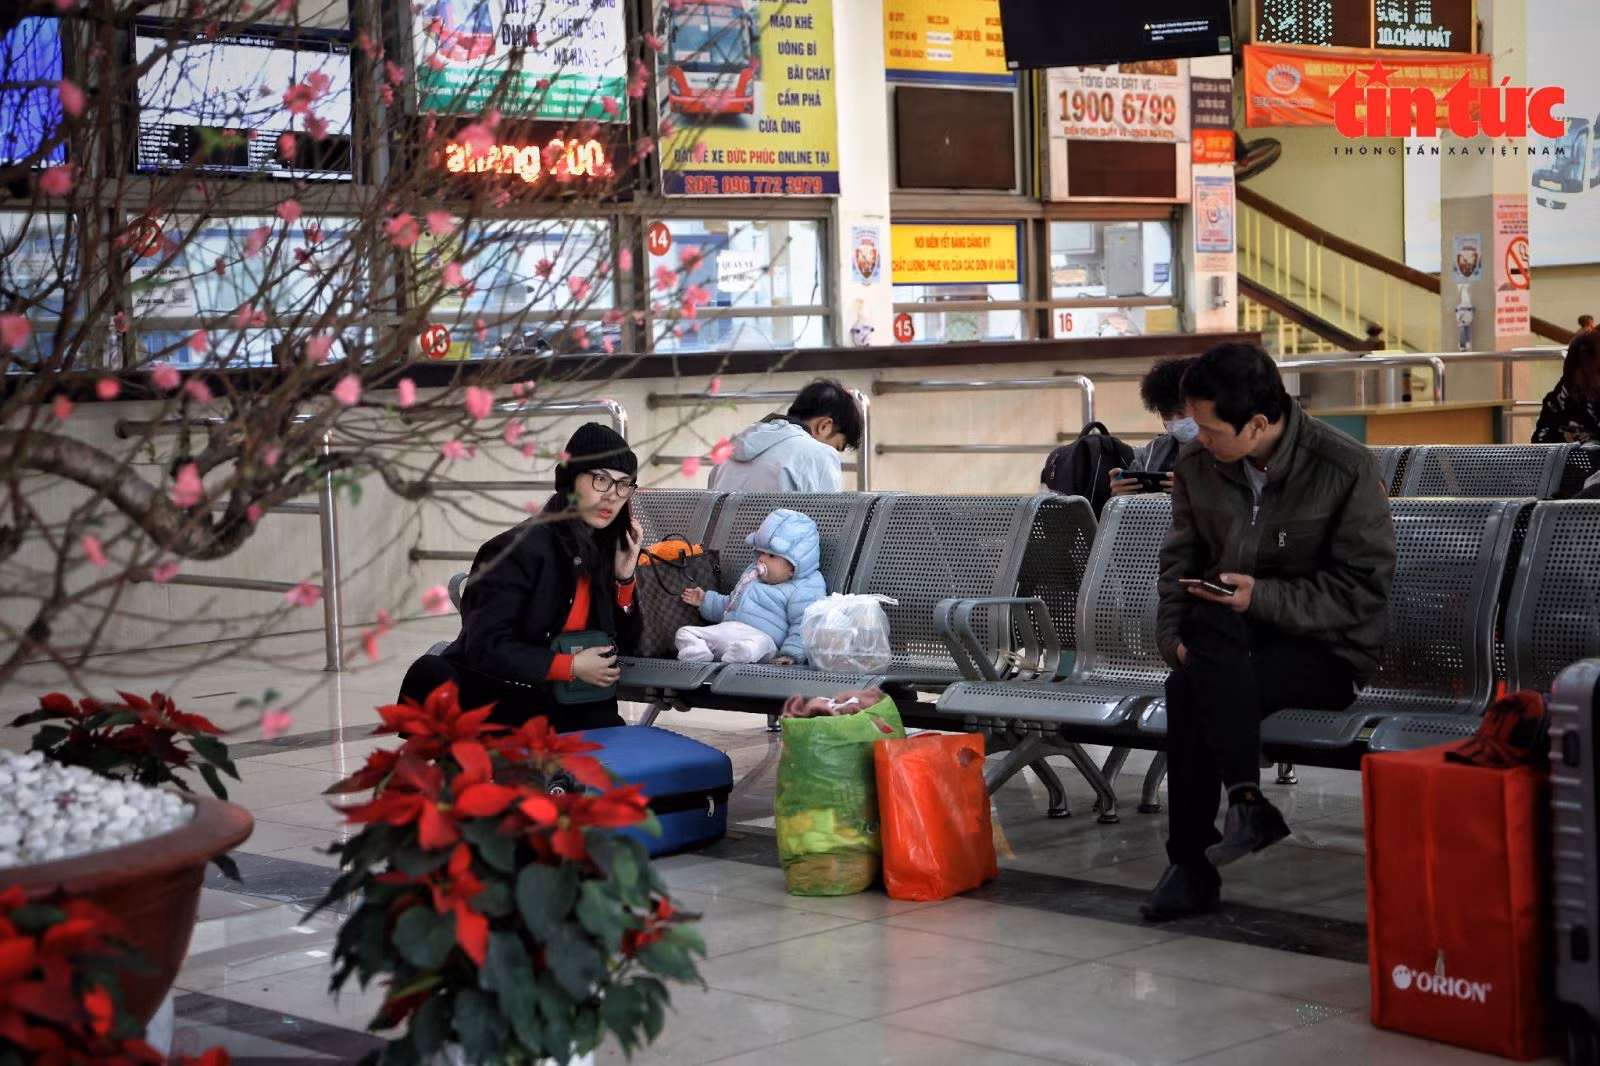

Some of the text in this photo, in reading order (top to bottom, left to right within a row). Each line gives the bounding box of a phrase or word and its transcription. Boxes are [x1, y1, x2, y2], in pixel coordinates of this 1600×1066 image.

[1059, 90, 1177, 126] 1900 6799
[780, 116, 801, 133] ÔNG
[711, 150, 724, 164] XE
[726, 147, 747, 164] ĐỨC
[749, 147, 776, 164] PHÚC
[777, 150, 812, 164] ONLINE
[721, 175, 750, 193] 096
[752, 175, 782, 193] 772
[785, 175, 823, 193] 3979
[649, 230, 668, 248] 14
[895, 319, 913, 337] 15
[1059, 312, 1073, 332] 16
[426, 329, 448, 353] 13
[1416, 971, 1487, 1004] ORION
